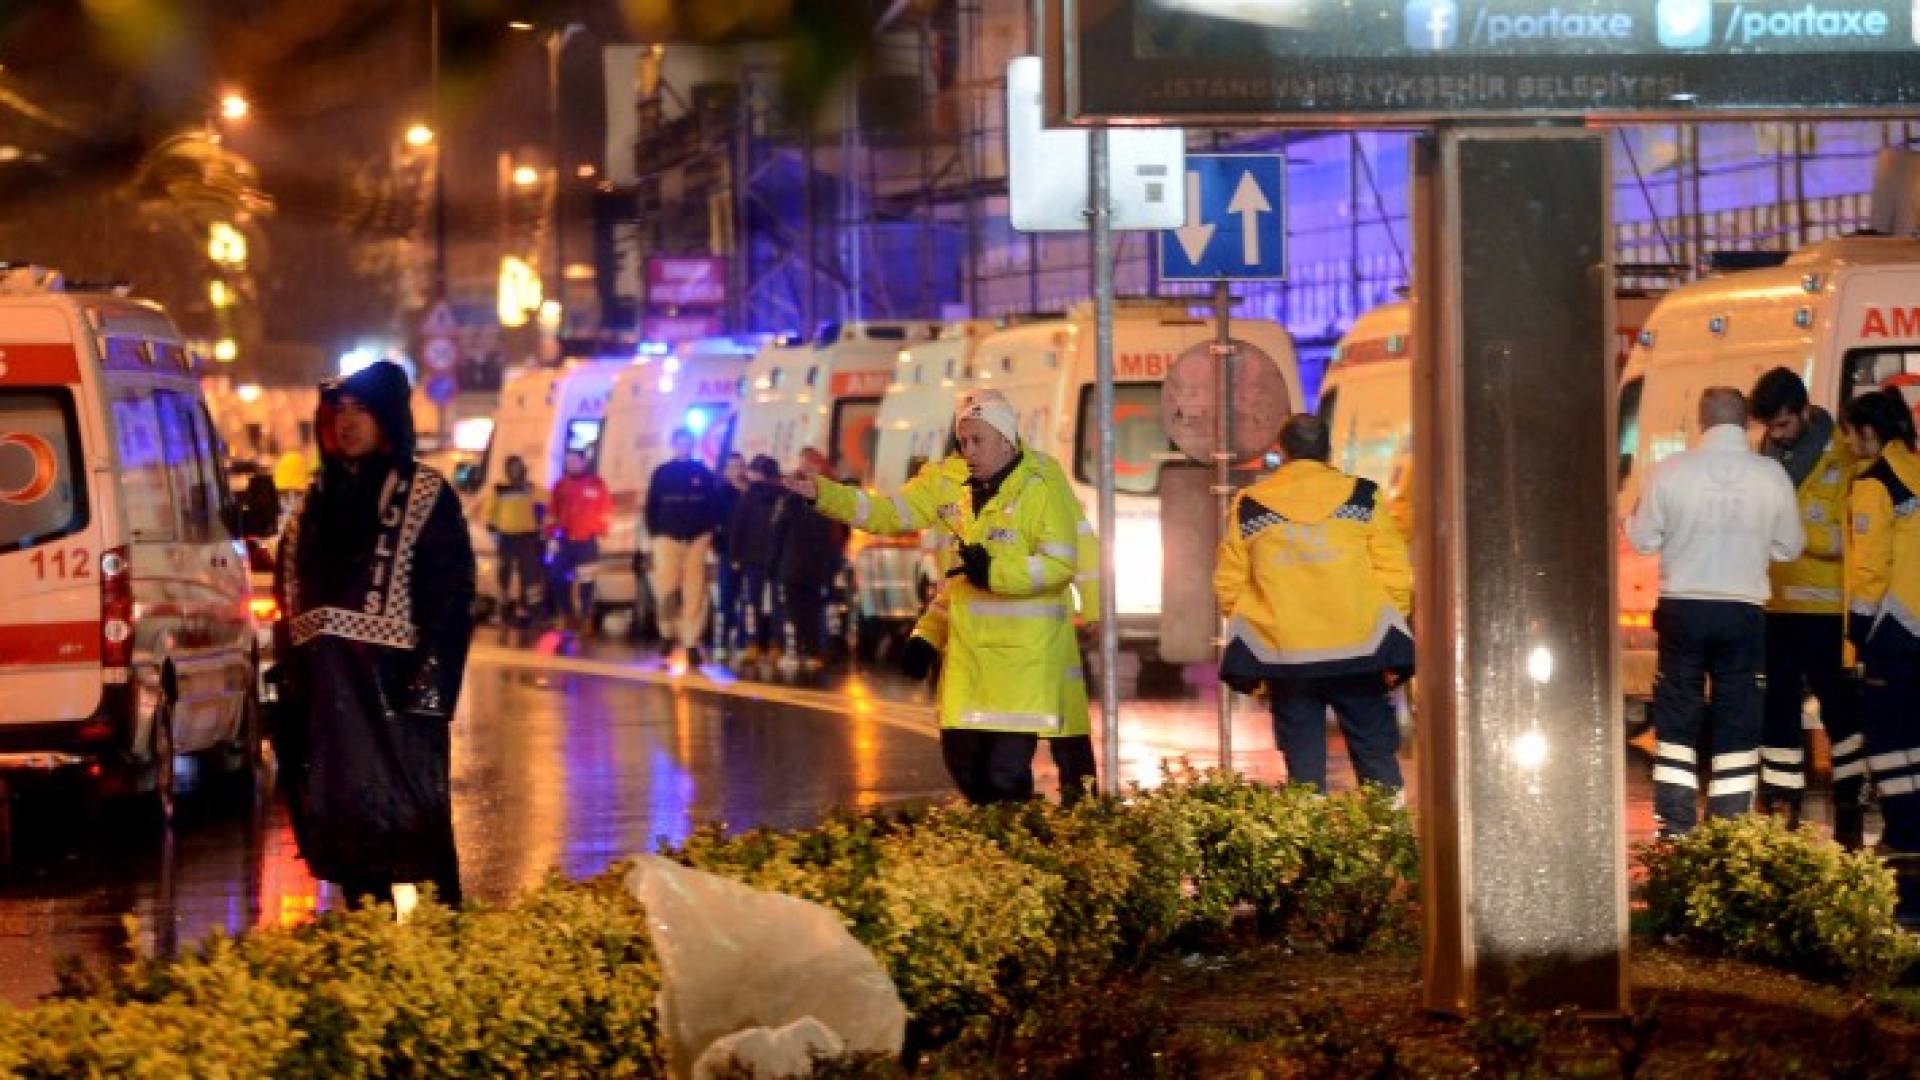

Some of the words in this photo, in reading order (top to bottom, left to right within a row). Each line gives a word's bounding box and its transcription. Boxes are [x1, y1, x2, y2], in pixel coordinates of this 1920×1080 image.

[1470, 8, 1633, 46] /portaxe
[1725, 4, 1889, 44] /portaxe
[30, 549, 90, 579] 112
